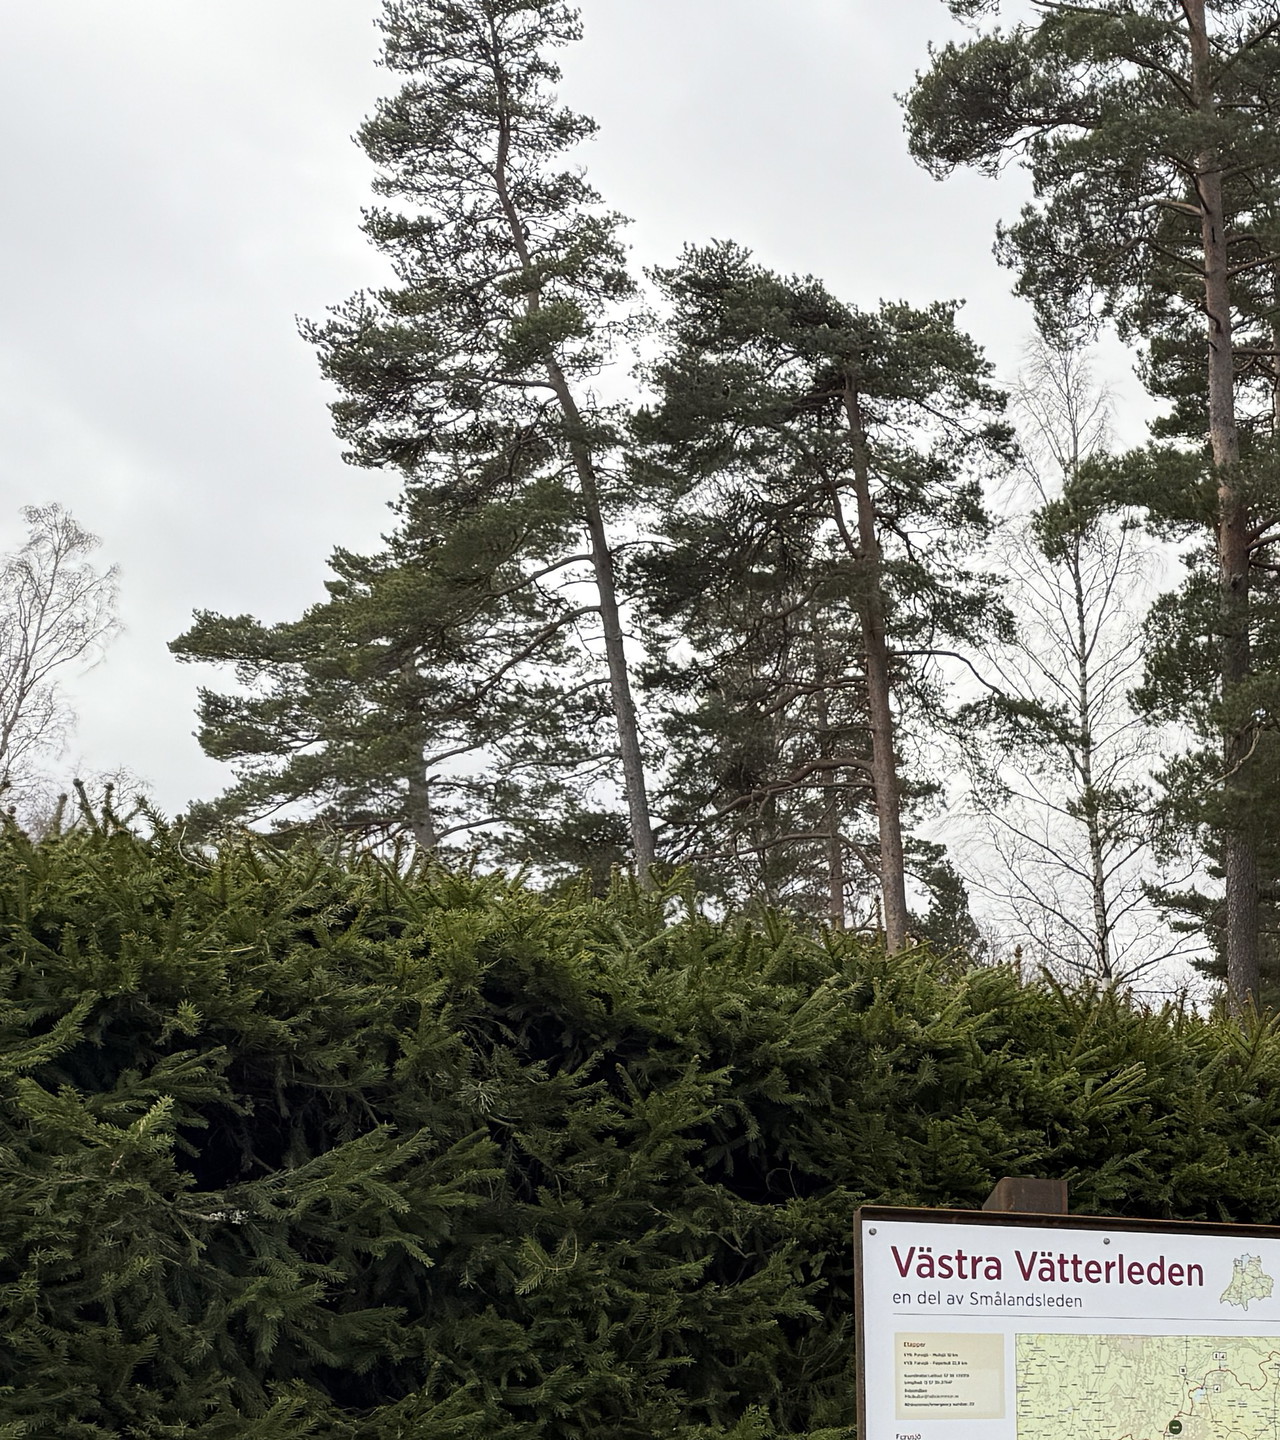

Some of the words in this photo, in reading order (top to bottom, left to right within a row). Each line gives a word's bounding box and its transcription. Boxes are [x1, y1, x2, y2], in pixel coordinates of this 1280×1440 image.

[890, 1245, 1002, 1280] Västra
[1014, 1250, 1204, 1286] Vätterleden
[892, 1292, 911, 1305] en
[917, 1291, 941, 1305] del
[946, 1292, 964, 1306] av
[969, 1291, 1083, 1308] Smålandsleden
